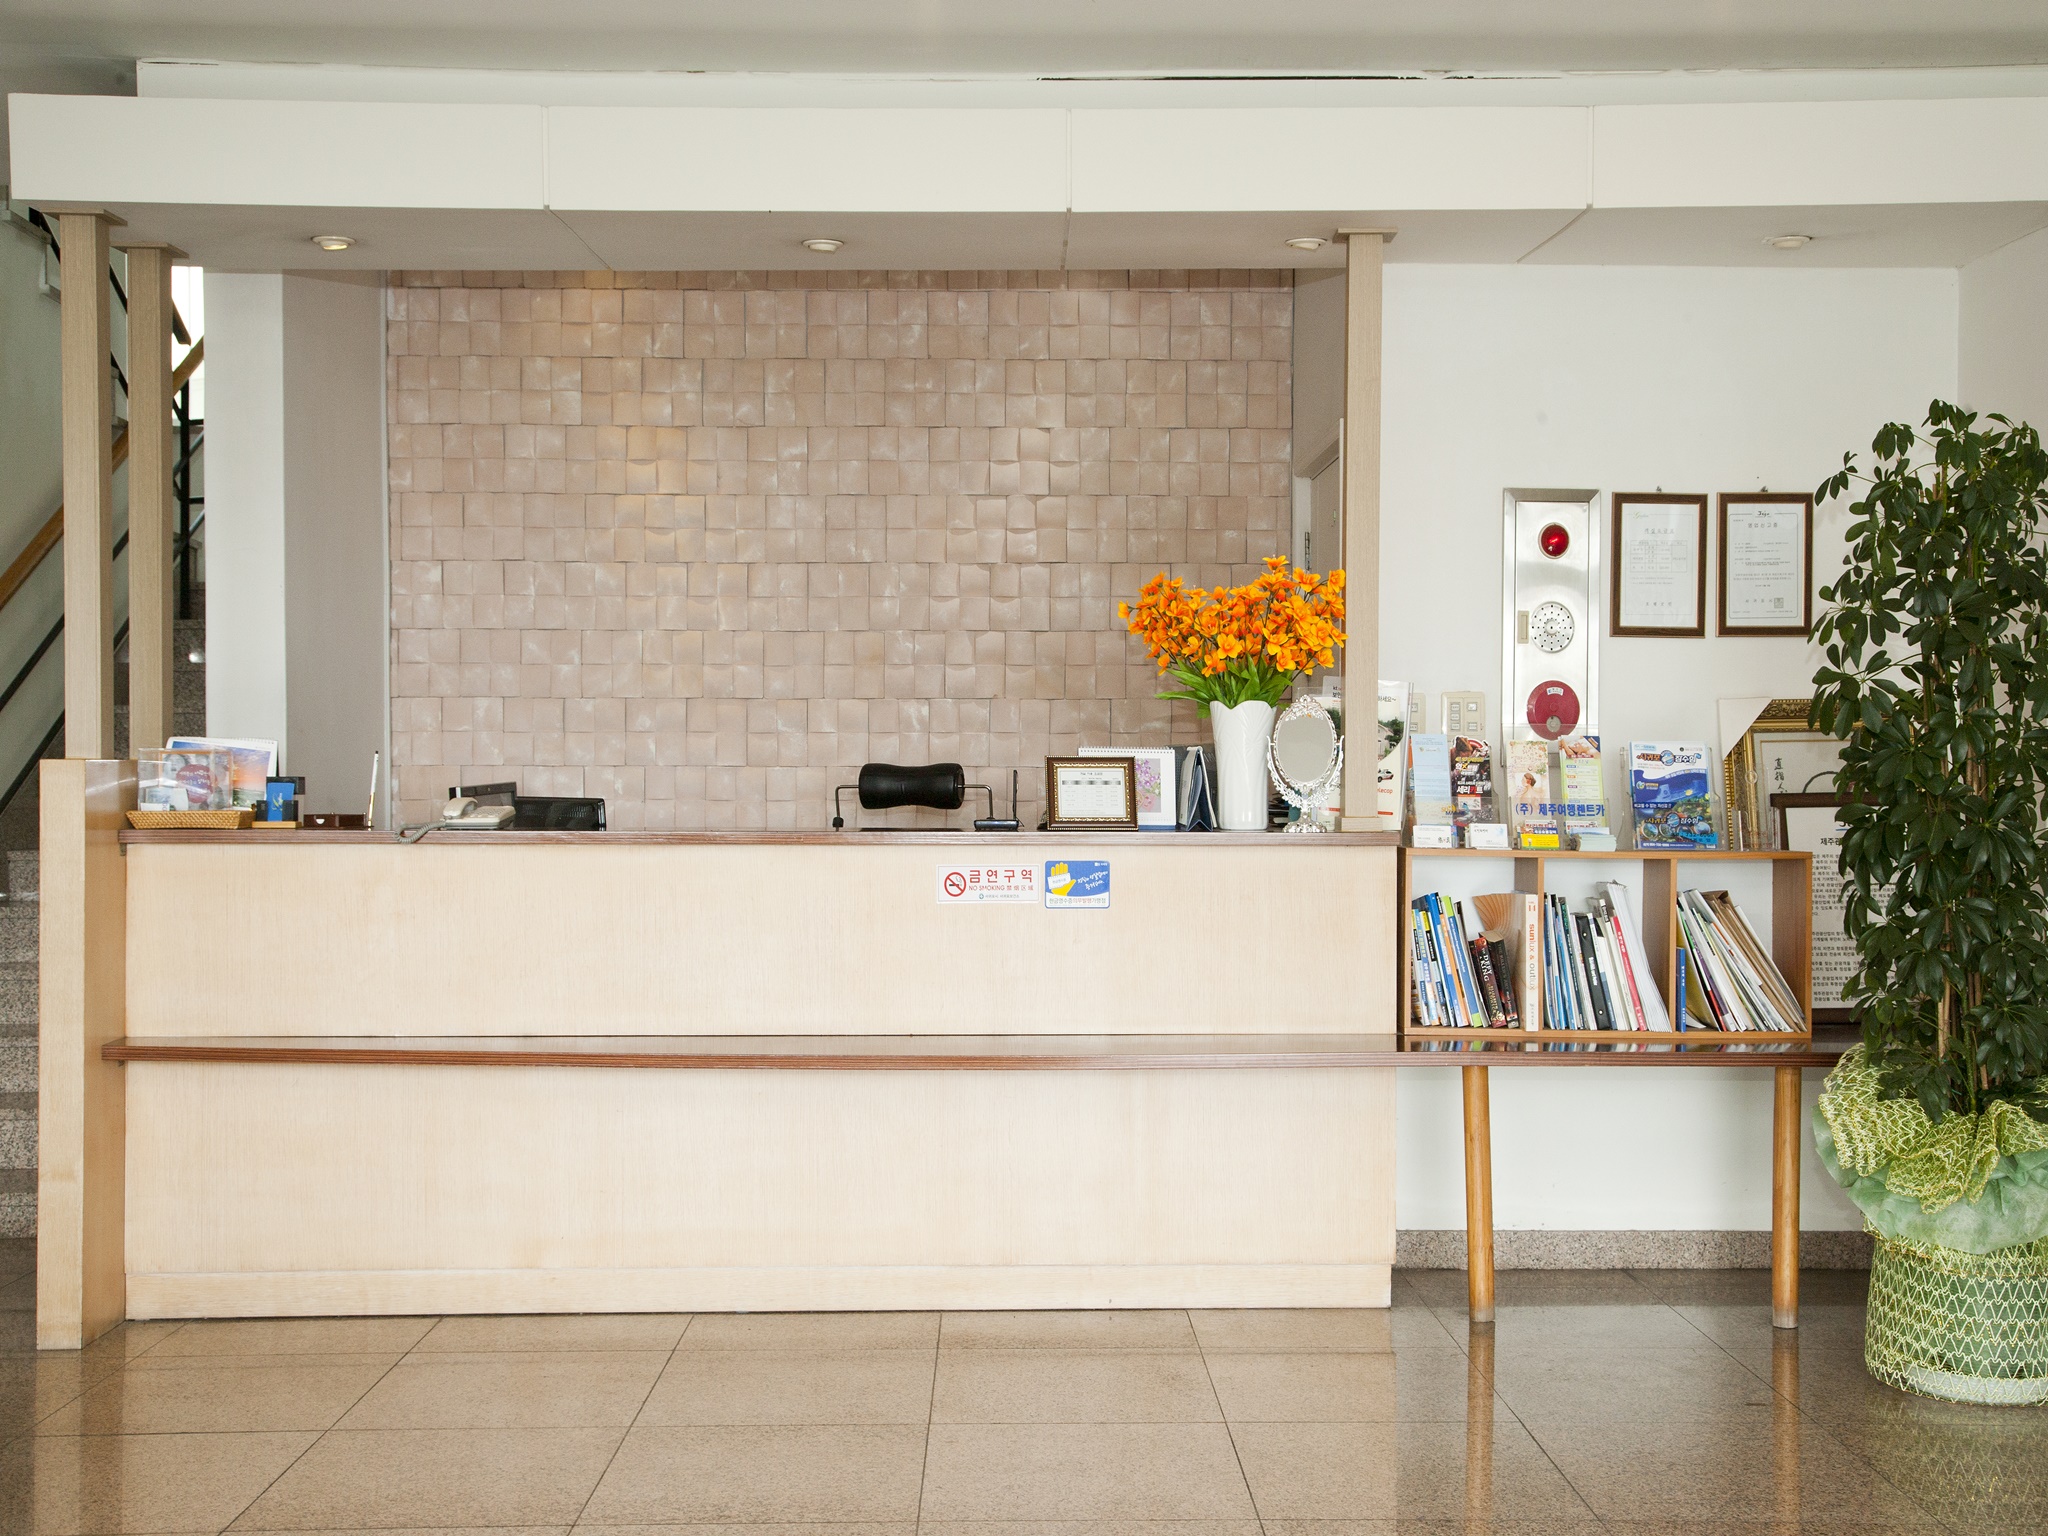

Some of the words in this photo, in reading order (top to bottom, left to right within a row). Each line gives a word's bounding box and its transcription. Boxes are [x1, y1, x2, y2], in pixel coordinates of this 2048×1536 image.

[1516, 803, 1533, 815] (주)
[1538, 803, 1605, 817] 제주여행렌트카
[969, 869, 1033, 883] 금연구역
[1479, 960, 1490, 982] KING
[1483, 954, 1493, 975] DEFY
